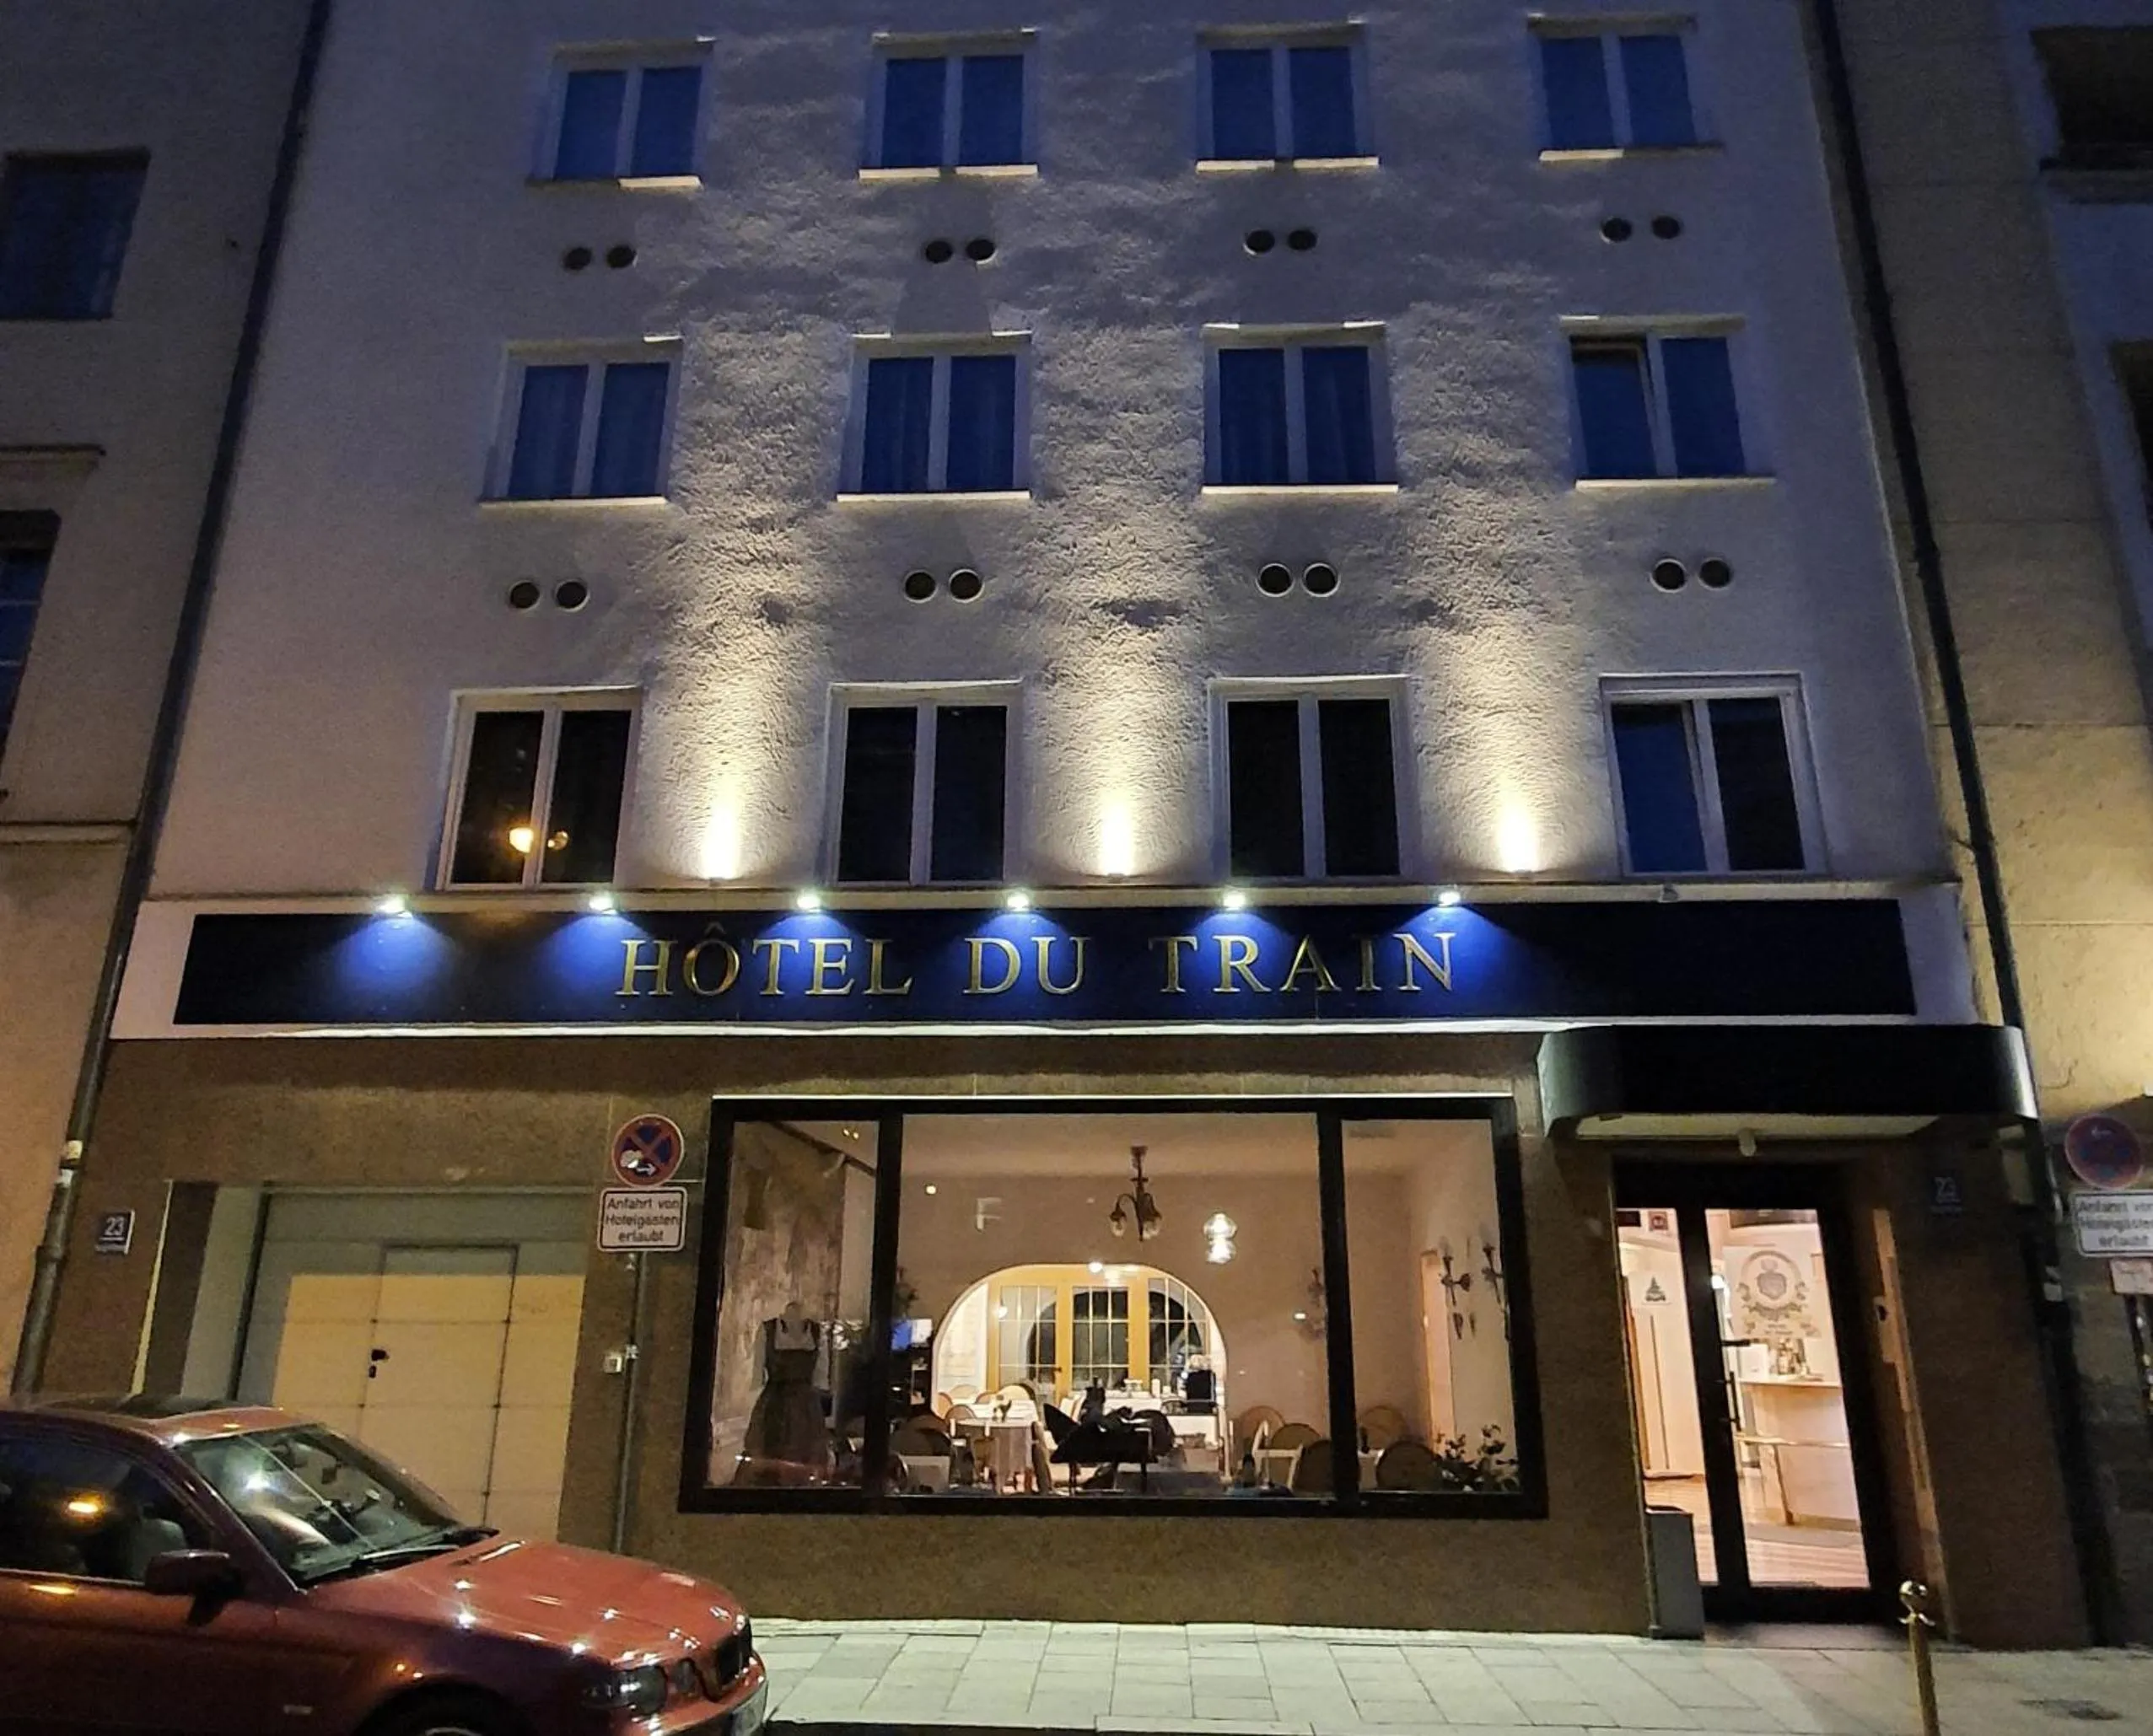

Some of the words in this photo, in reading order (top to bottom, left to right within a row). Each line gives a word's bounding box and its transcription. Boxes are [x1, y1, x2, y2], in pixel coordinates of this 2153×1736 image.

[615, 922, 913, 997] HÔTEL
[963, 937, 1090, 995] DU
[1149, 933, 1456, 993] TRAIN
[606, 1197, 652, 1210] Anfahrt
[659, 1200, 680, 1209] von
[105, 1217, 125, 1236] 23
[618, 1229, 664, 1242] erlaubt
